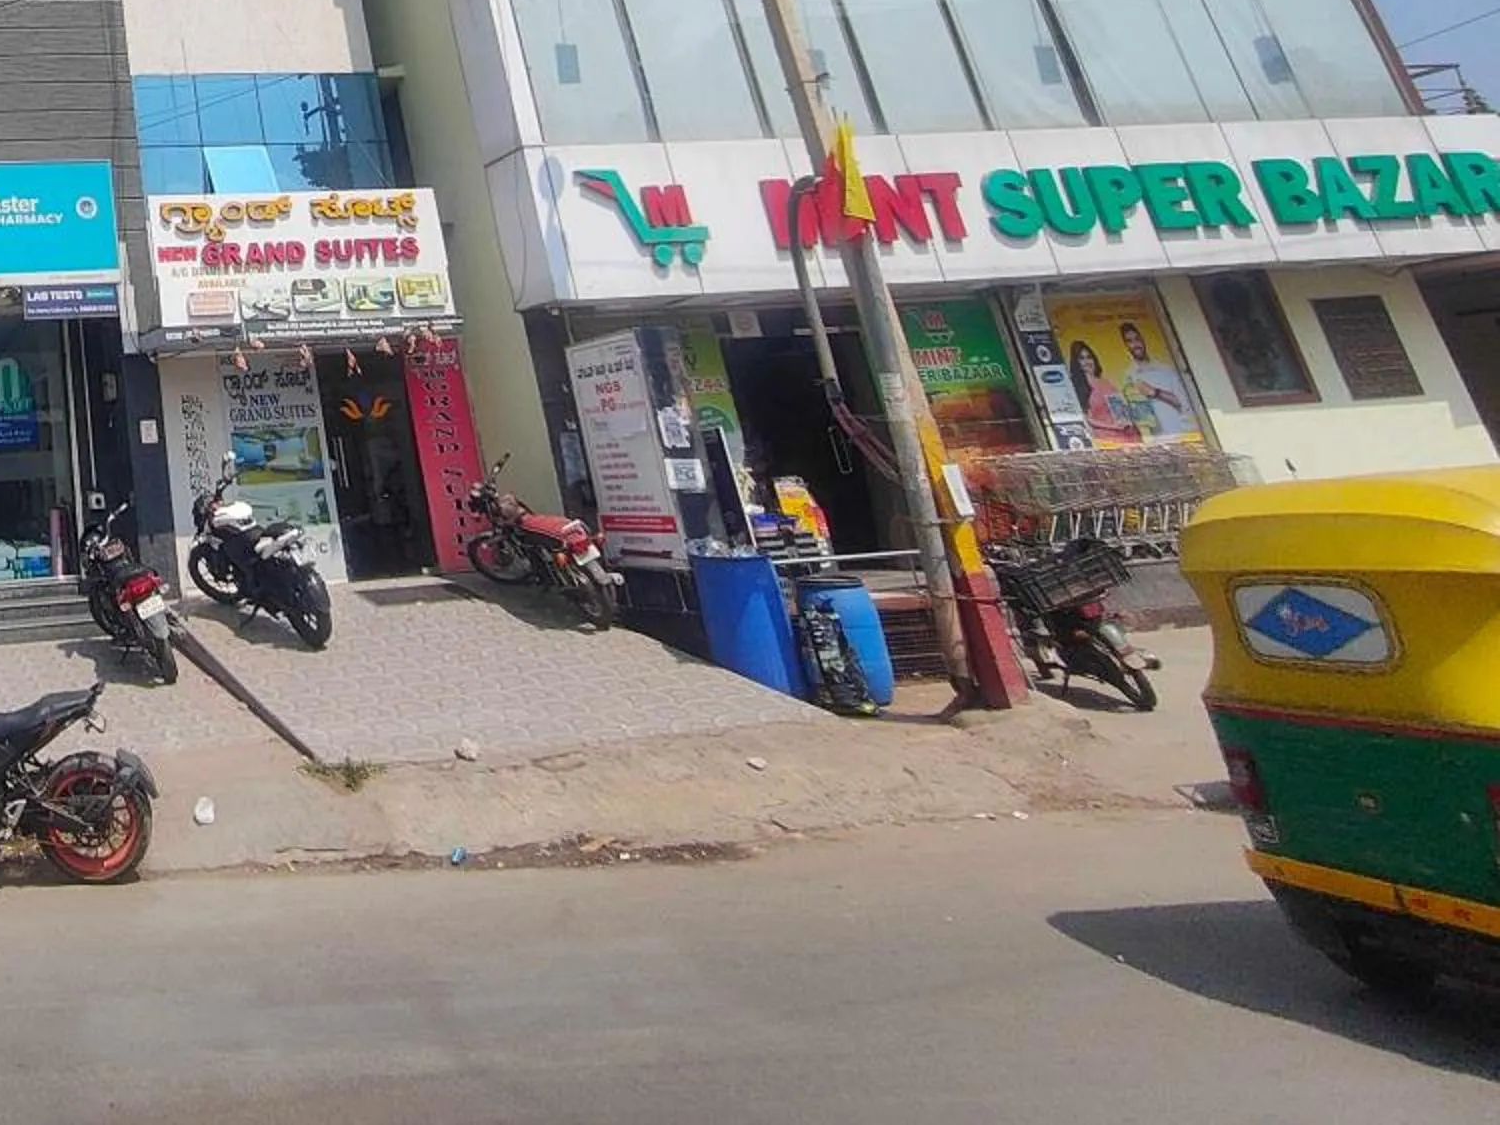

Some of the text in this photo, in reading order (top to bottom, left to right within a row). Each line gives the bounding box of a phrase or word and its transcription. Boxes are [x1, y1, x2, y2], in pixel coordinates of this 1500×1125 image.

[758, 152, 1500, 250] MNT SUPER BAZAR
[201, 241, 306, 266] GRAND
[314, 237, 420, 264] SUITES
[229, 403, 316, 422] GRAND SUITES
[250, 394, 280, 407] NEW
